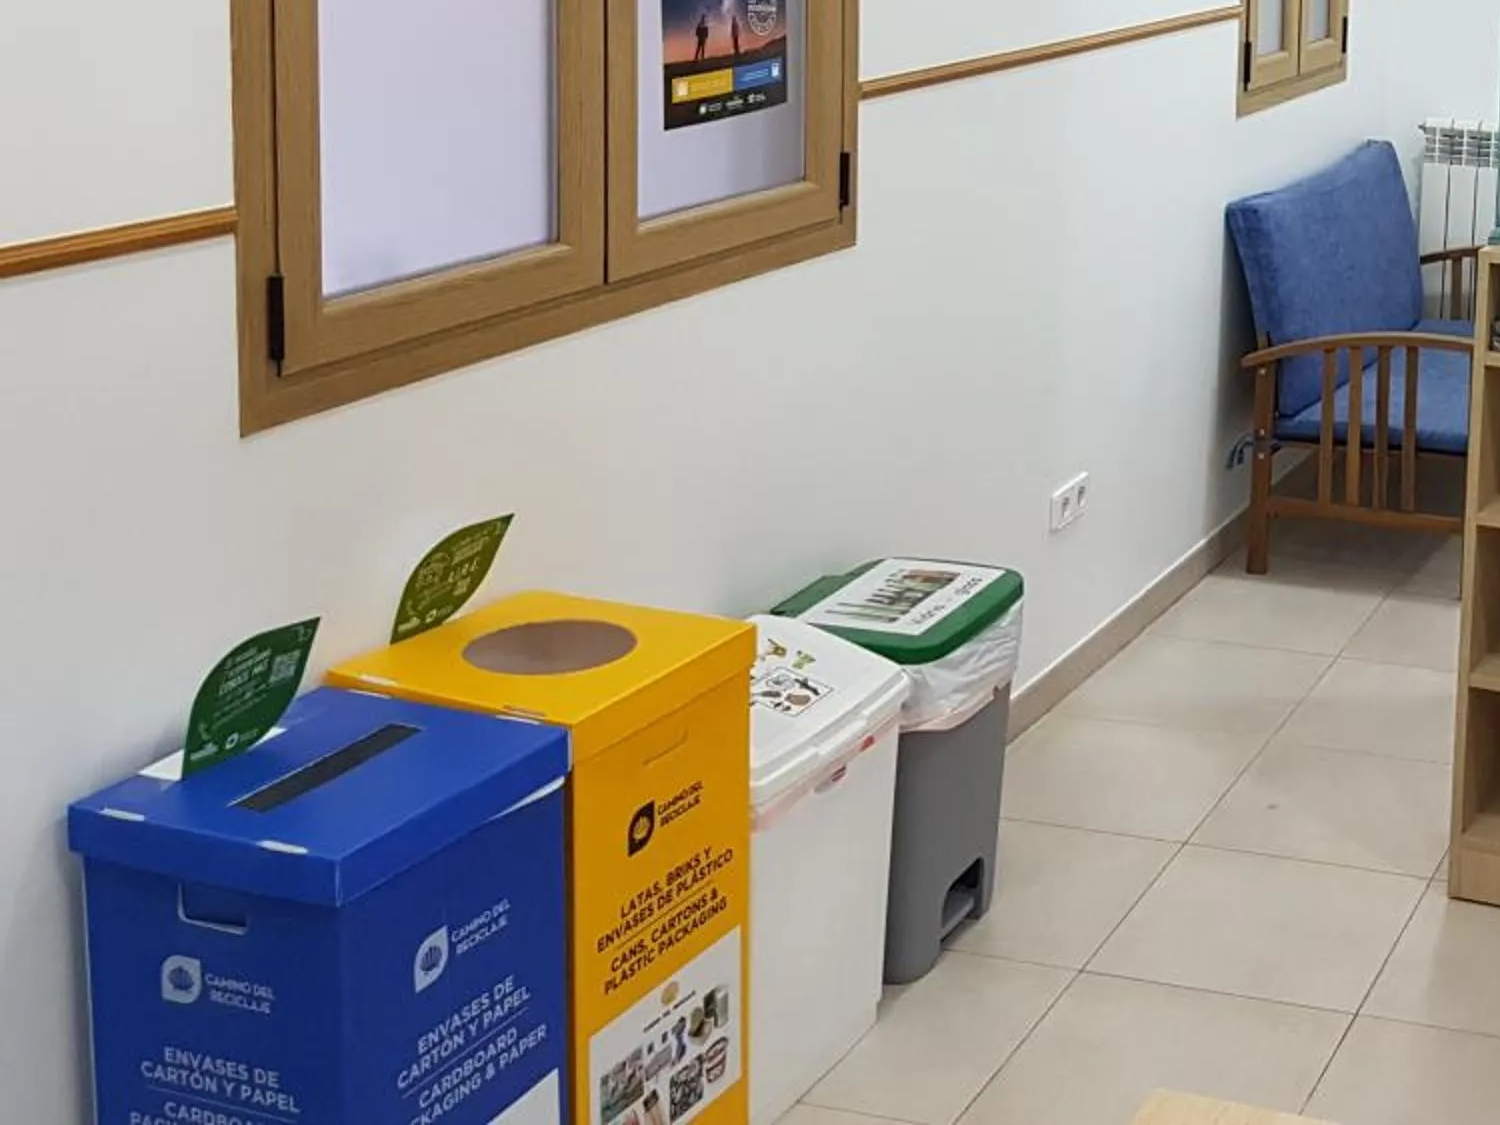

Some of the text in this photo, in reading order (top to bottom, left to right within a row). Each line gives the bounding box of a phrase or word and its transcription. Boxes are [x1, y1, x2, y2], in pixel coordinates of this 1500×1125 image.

[666, 853, 701, 886] BRIKS
[704, 846, 712, 860] Y
[451, 910, 492, 943] CAMINO
[597, 902, 654, 953] ENVASES
[657, 888, 673, 910] DE
[651, 894, 708, 942] CARTONS
[711, 886, 719, 900] &
[604, 896, 727, 995] PLASTIC PACKAGING
[205, 973, 251, 994] CAMINO
[418, 975, 514, 1055] ENVASES DE
[470, 1018, 479, 1037] Y
[483, 986, 531, 1029] PAPEL
[164, 1047, 280, 1088] ENVASES DE
[419, 1026, 518, 1109] CARDBOARD
[499, 1024, 547, 1069] PAPER
[140, 1061, 301, 1114] CARTÓN Y PAPEL
